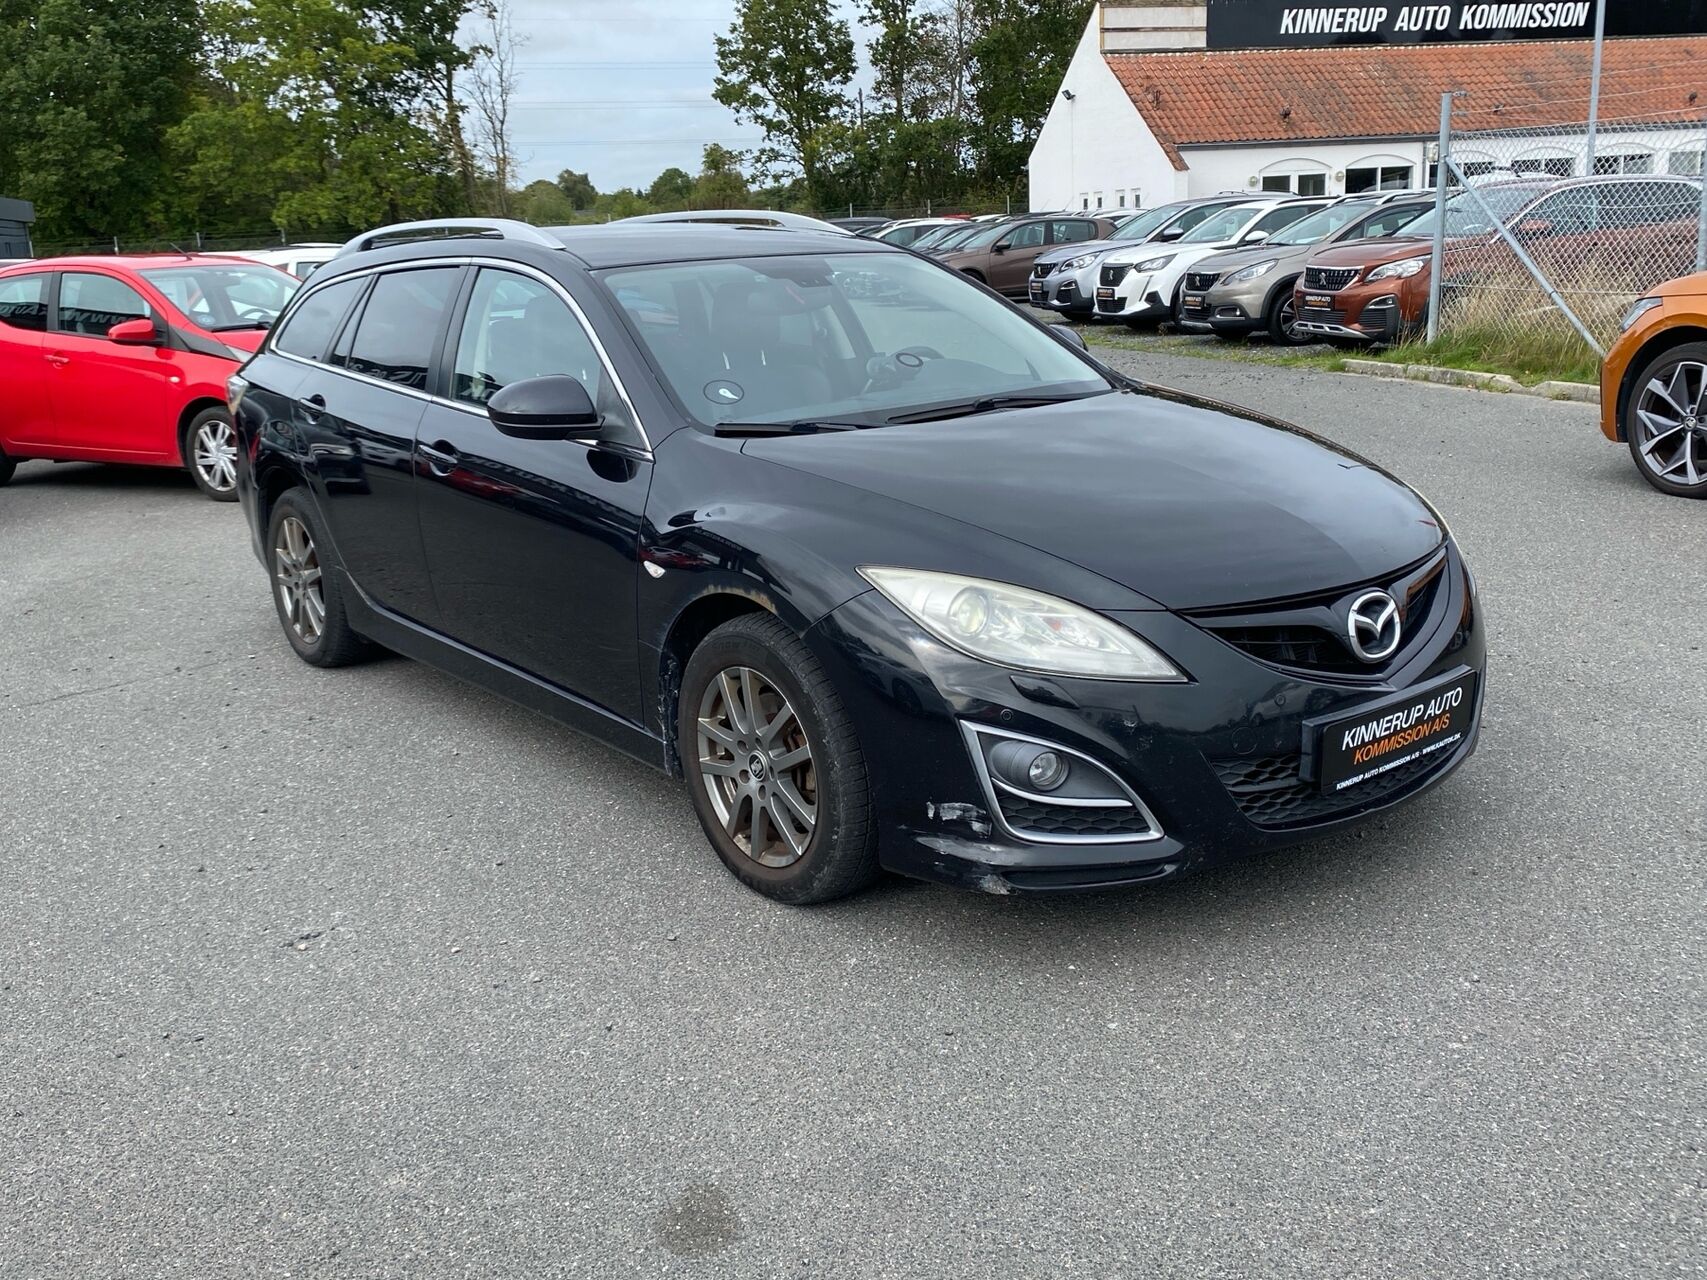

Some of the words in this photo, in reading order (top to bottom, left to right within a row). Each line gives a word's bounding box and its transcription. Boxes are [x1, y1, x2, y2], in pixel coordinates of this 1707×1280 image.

[1280, 8, 1388, 34] KINNERUP
[1394, 5, 1451, 31] AUTO
[1459, 2, 1590, 30] KOMMISSION
[1342, 704, 1424, 750] KINNERUP
[1424, 687, 1462, 720] AUTO
[1354, 721, 1431, 765] KOMMISSION
[1431, 713, 1450, 735] A/S
[1364, 768, 1378, 780] AUTO
